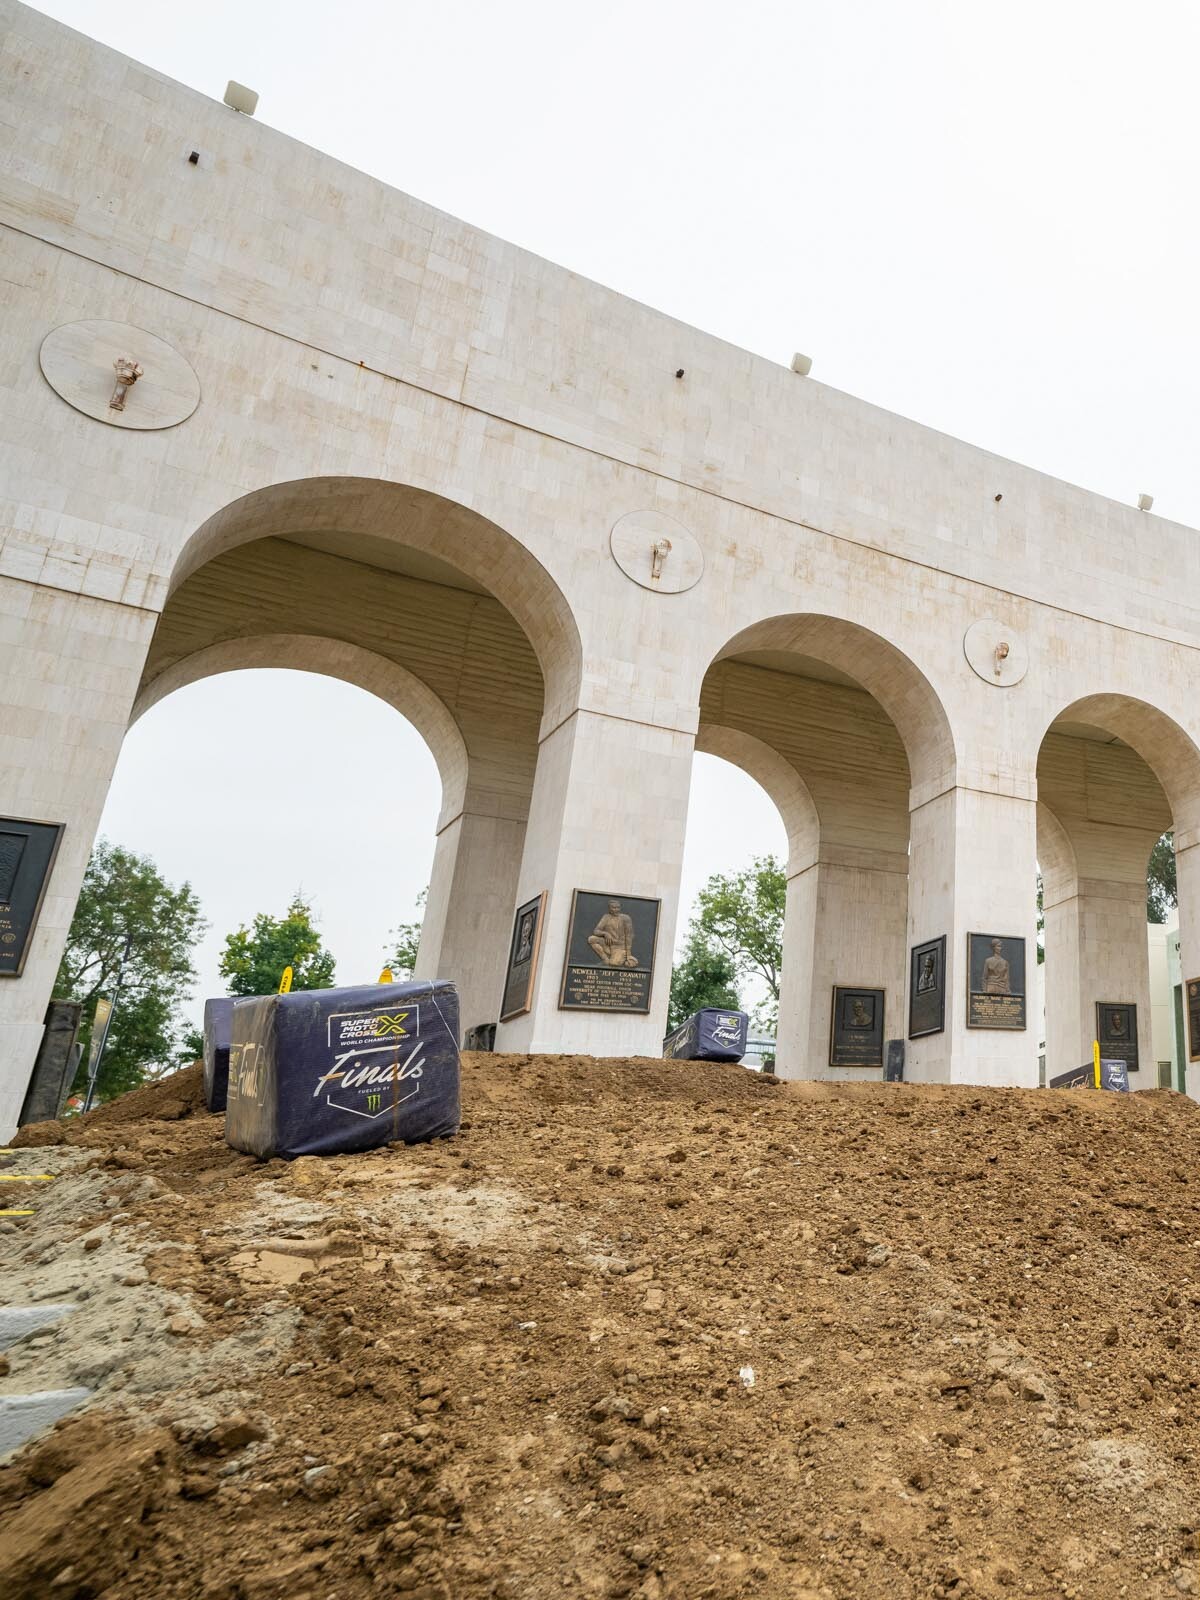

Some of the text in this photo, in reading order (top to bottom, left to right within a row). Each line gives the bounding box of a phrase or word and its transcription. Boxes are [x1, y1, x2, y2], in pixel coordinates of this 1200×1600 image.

[340, 1017, 379, 1027] SUPER
[342, 1024, 378, 1032] MOTO
[339, 1030, 378, 1039] CROSS
[712, 1026, 741, 1040] Finals
[364, 1034, 410, 1043] CHAMPIONSHIP
[313, 1042, 426, 1097] Finals
